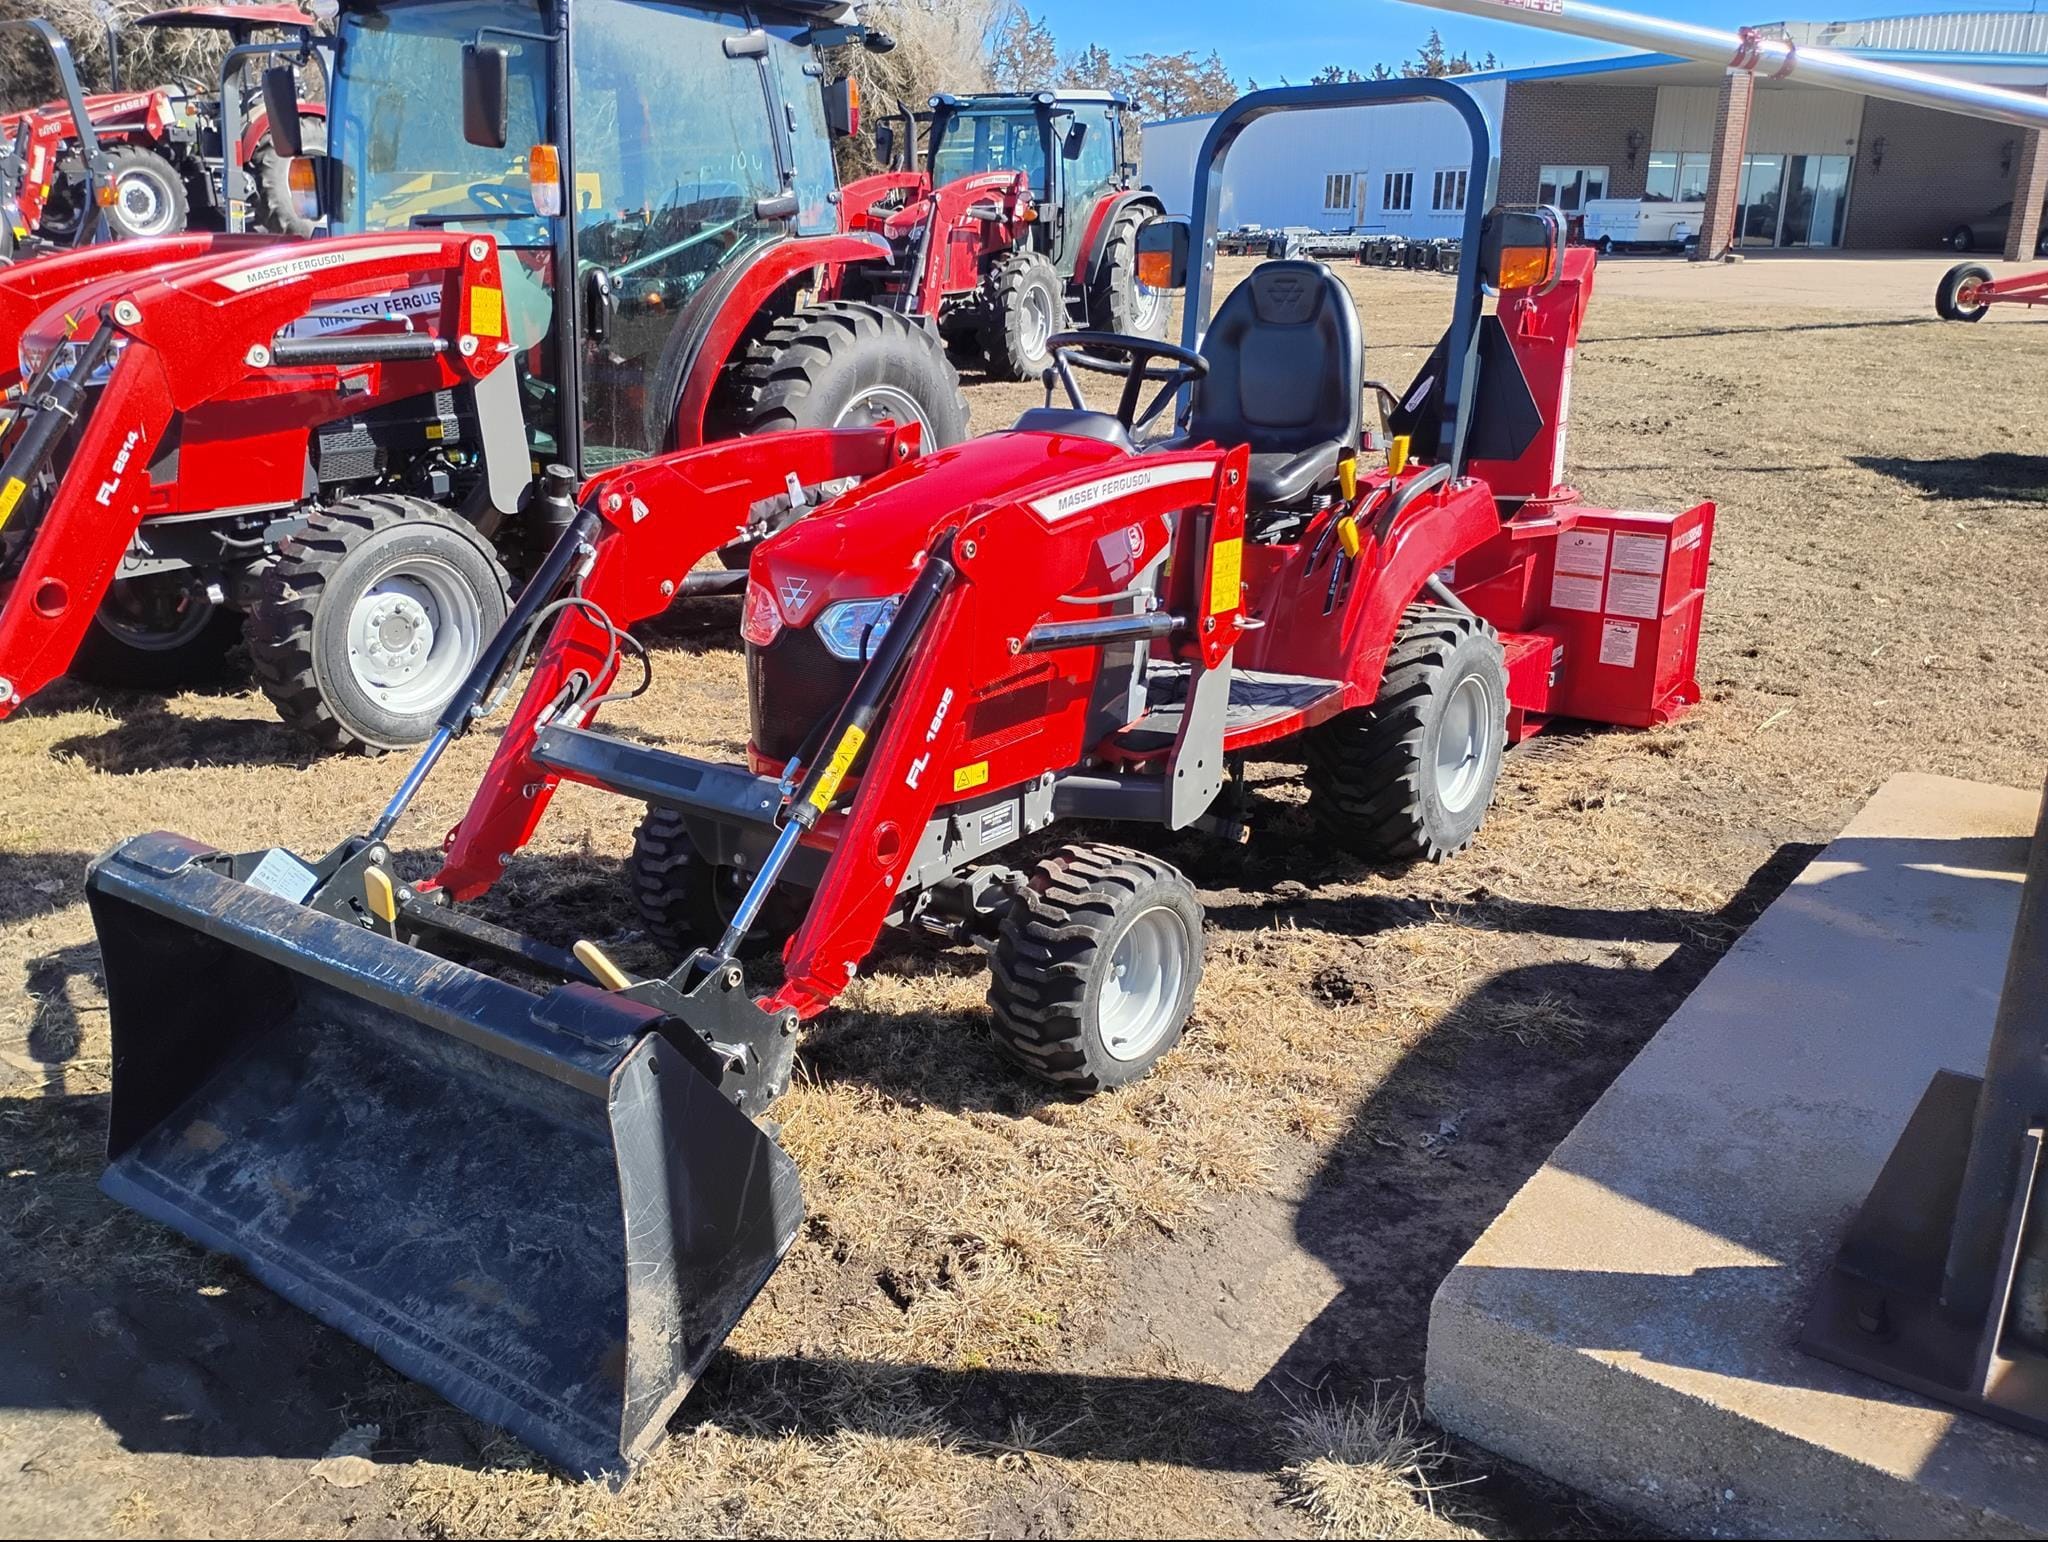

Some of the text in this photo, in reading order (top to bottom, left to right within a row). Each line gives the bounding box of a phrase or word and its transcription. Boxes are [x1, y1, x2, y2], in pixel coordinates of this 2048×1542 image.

[113, 99, 139, 113] CASE
[247, 253, 346, 284] MASSEY FERGUSON
[95, 430, 139, 507] FL 2814
[1058, 471, 1151, 511] MASSEY FERGUSON
[905, 686, 954, 790] FL 1805
